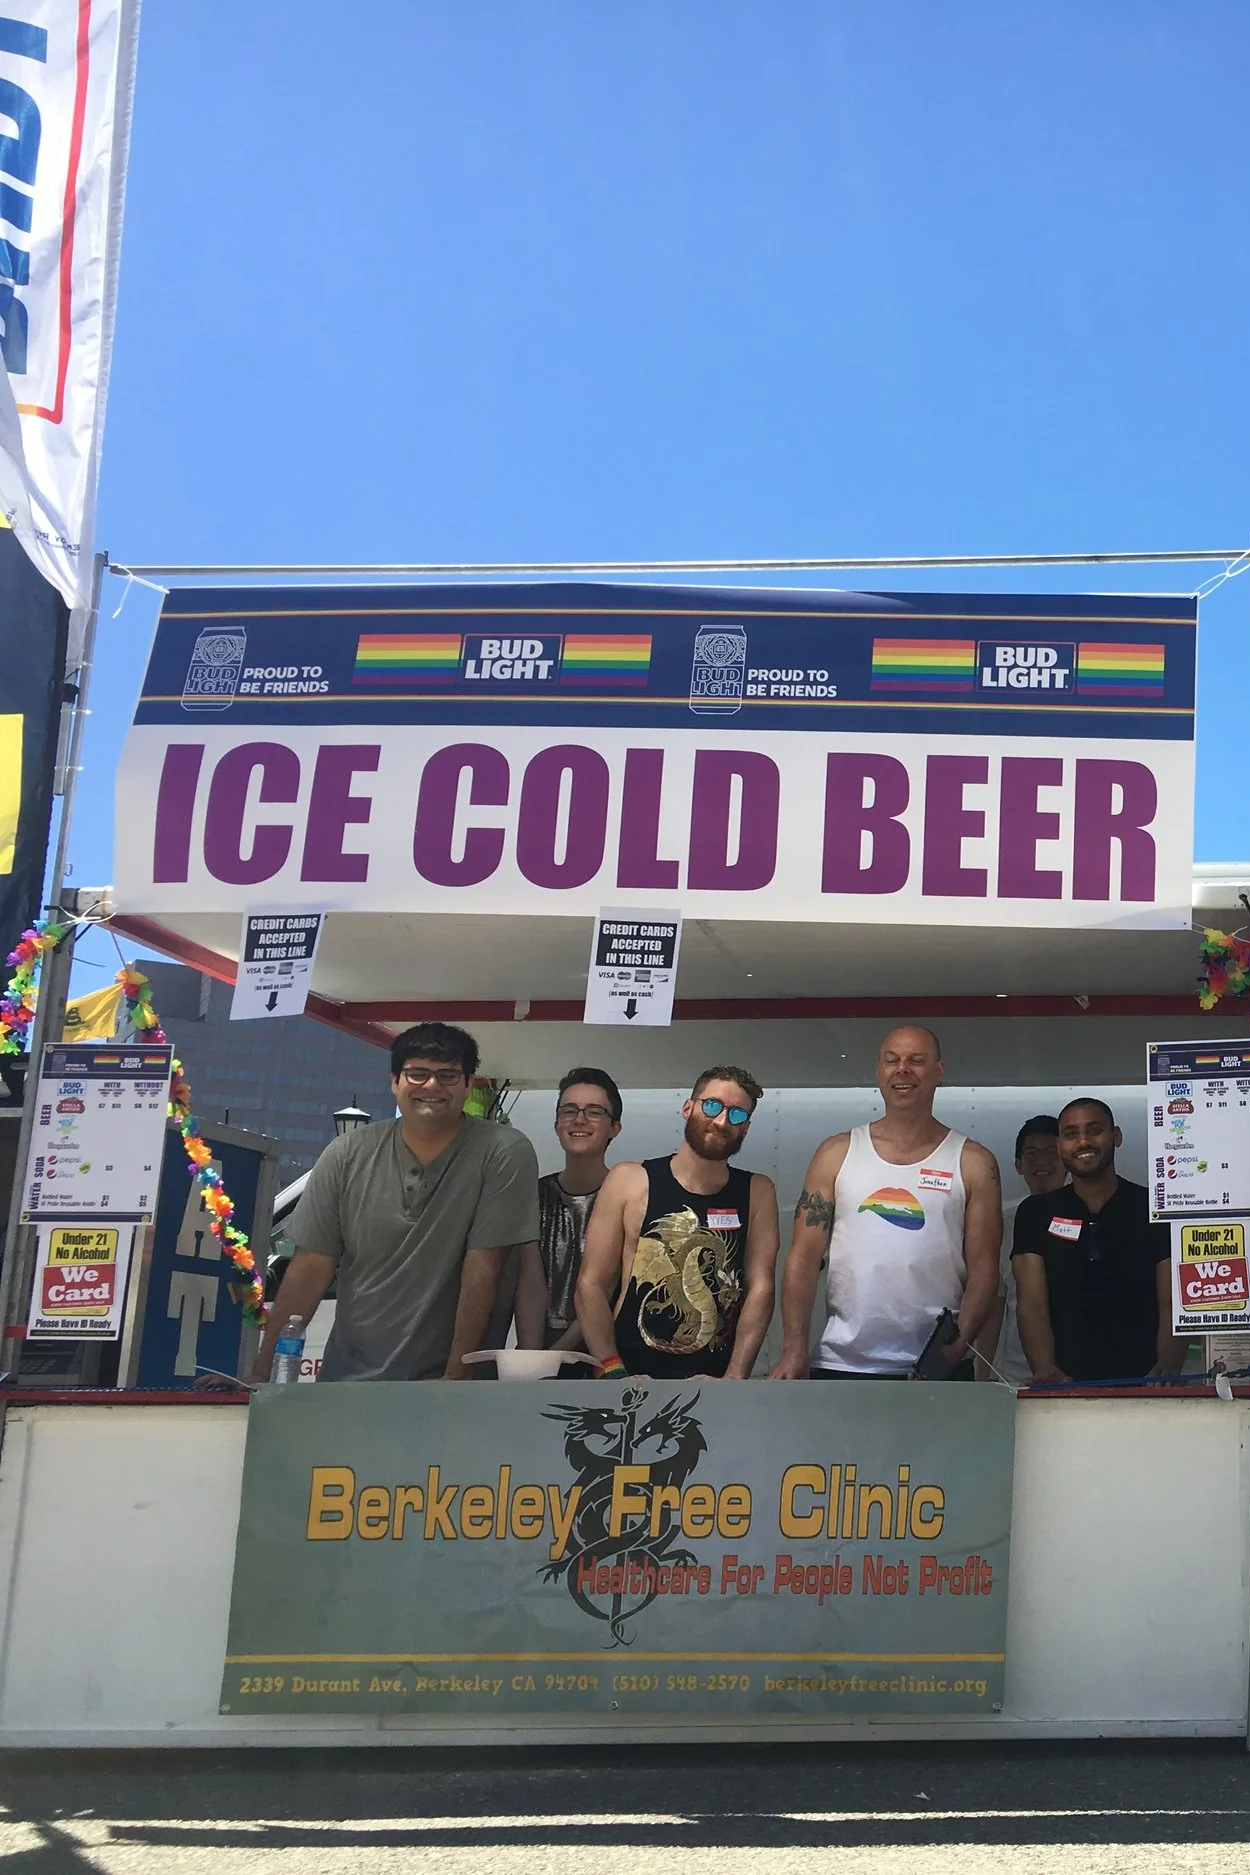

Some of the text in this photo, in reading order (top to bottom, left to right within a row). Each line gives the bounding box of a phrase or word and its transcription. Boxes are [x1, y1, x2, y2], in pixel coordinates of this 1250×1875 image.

[479, 638, 543, 660] BUD
[995, 647, 1058, 666] BUD
[243, 666, 323, 679] PROUD TO
[464, 658, 551, 680] LIGHT
[748, 669, 829, 682] PROUD TO
[981, 667, 1068, 690] LIGHT
[239, 681, 329, 694] BE FRIENDS
[746, 684, 837, 697] BE FRIENDS
[153, 742, 1158, 902] ICE COLD BEER
[250, 918, 318, 930] CREDIT CARDS
[602, 924, 674, 937] CREDIT CARDS
[259, 932, 306, 944] ACCEPTED
[611, 938, 662, 951] ACCEPTED
[253, 946, 307, 959] IN THIS LINE
[605, 953, 665, 965] IN THIS LINE
[1154, 1106, 1163, 1127] BEER
[1178, 1156, 1198, 1164] pepsi
[1156, 1157, 1165, 1178] SODA
[1157, 1183, 1165, 1210] WATER
[62, 1233, 107, 1245] Under 21
[1192, 1229, 1234, 1242] Under 21
[56, 1247, 110, 1260] No Alcohol
[1188, 1243, 1238, 1256] No Alcohol
[61, 1267, 99, 1282] We
[1195, 1262, 1231, 1279] We
[48, 1283, 110, 1301] Card
[1186, 1277, 1245, 1298] Card
[35, 1319, 111, 1329] Please Have ID Ready
[1179, 1313, 1250, 1324] Please Have ID Ready
[306, 1464, 946, 1559] Berkeley Free Clinic
[577, 1555, 993, 1606] Healthcare For People Not Profit
[239, 1675, 988, 1697] 2339 Durant Ave, Berkeley CA 94704 (510) 548-2570 berkeleyfreeclinic.org
